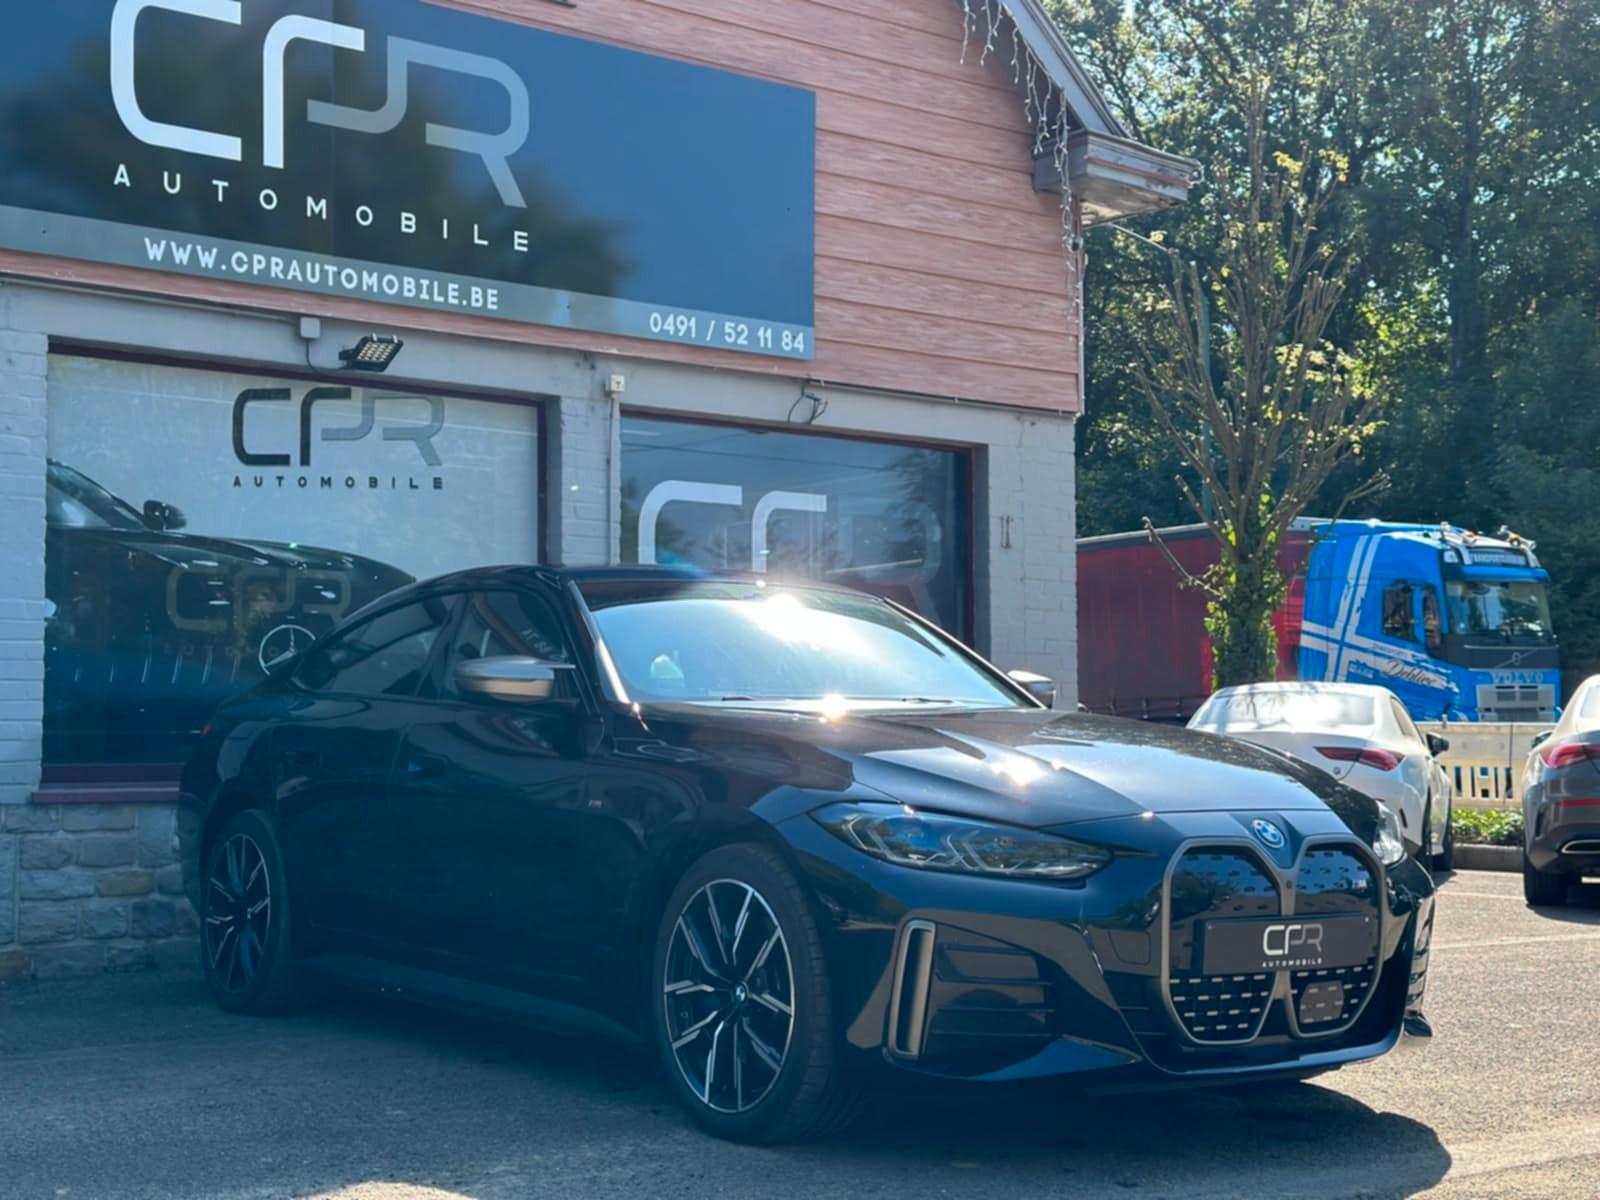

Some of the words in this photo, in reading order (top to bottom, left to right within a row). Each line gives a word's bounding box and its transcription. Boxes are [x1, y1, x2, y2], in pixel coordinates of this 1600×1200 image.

[109, 0, 531, 208] CPR
[114, 163, 530, 253] AUTOMOBILE
[143, 237, 499, 311] WWW.CPRAUTOMOBILE.BE
[649, 311, 697, 339] 0491
[706, 320, 716, 342] /
[724, 321, 749, 346] 52
[757, 326, 772, 349] 11
[781, 330, 805, 353] 84
[232, 387, 445, 467] CPR
[233, 474, 444, 491] AUTOMOBILE
[1488, 670, 1545, 685] VOLVO
[1263, 923, 1324, 956] CPR
[1261, 957, 1323, 969] AUTOMOBILE
